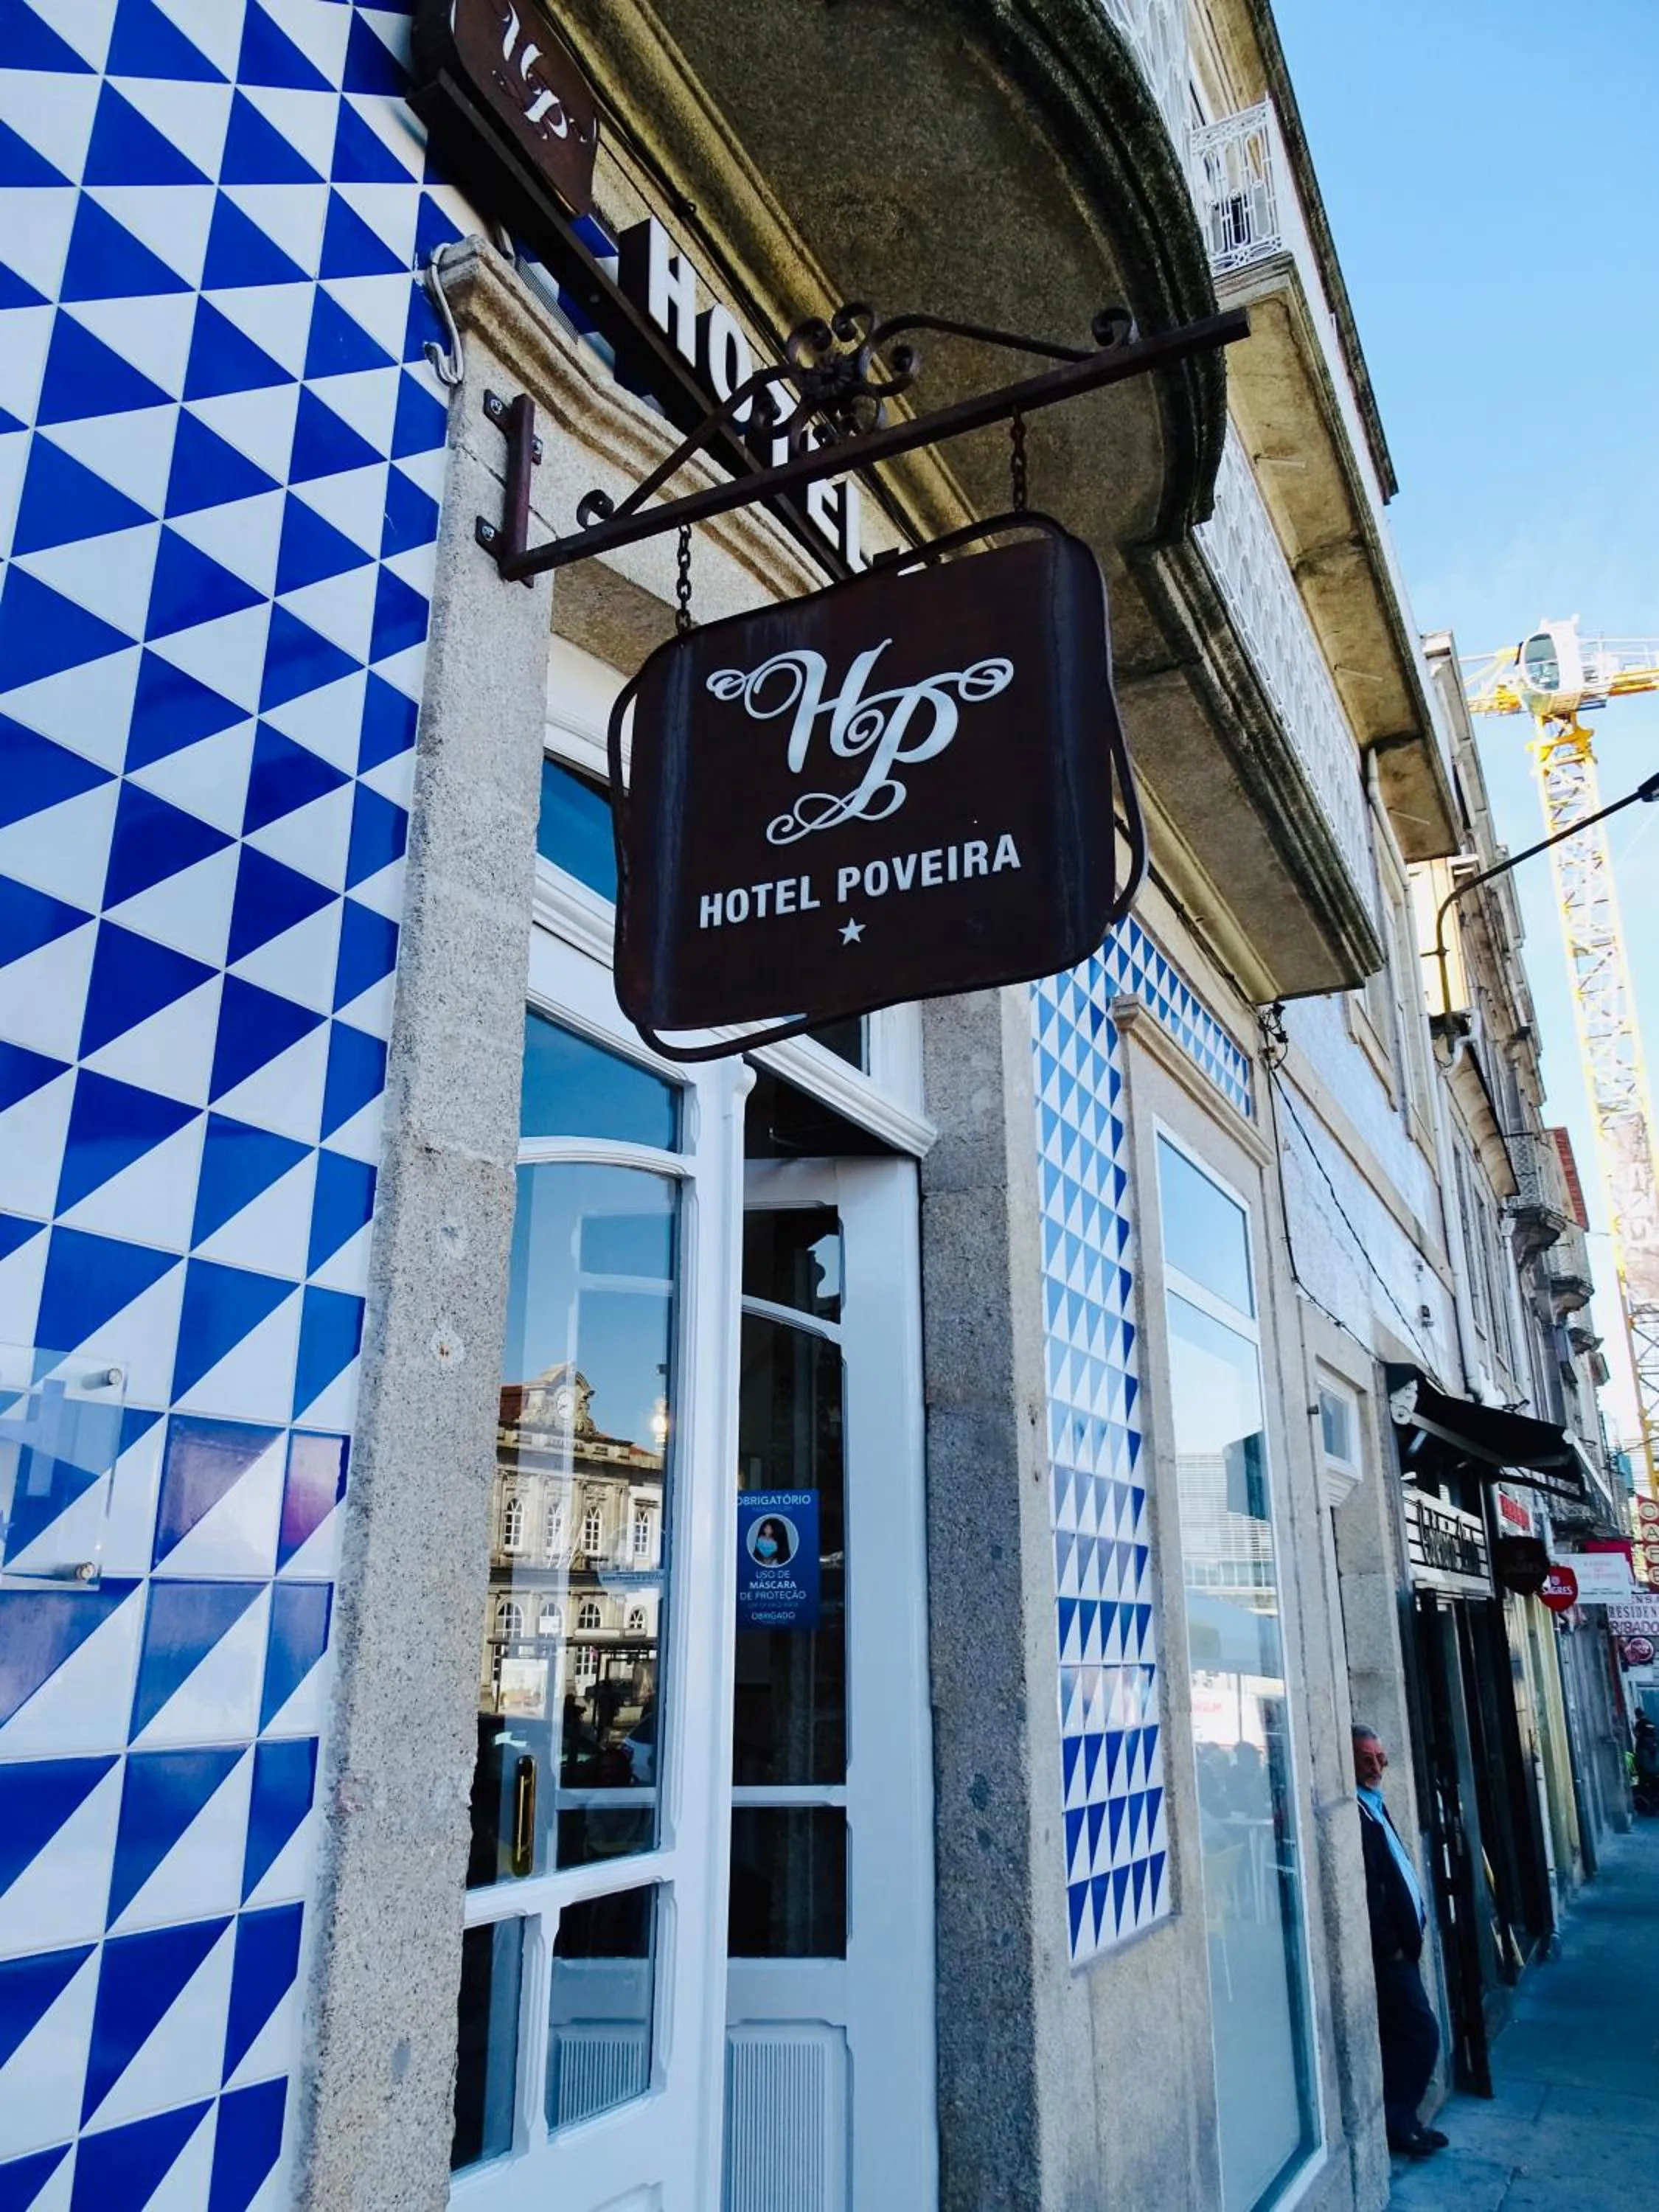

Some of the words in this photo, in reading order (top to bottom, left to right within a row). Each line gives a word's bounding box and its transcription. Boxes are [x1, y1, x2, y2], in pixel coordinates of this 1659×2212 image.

[706, 638, 1015, 845] HP
[698, 874, 821, 929] HOTEL
[837, 833, 1021, 903] POVEIRA
[755, 1570, 776, 1579] USO
[777, 1570, 790, 1579] DE
[749, 1579, 797, 1590] MÁSCARA
[740, 1592, 753, 1601] DE
[754, 1590, 807, 1601] PROTEÇÃO
